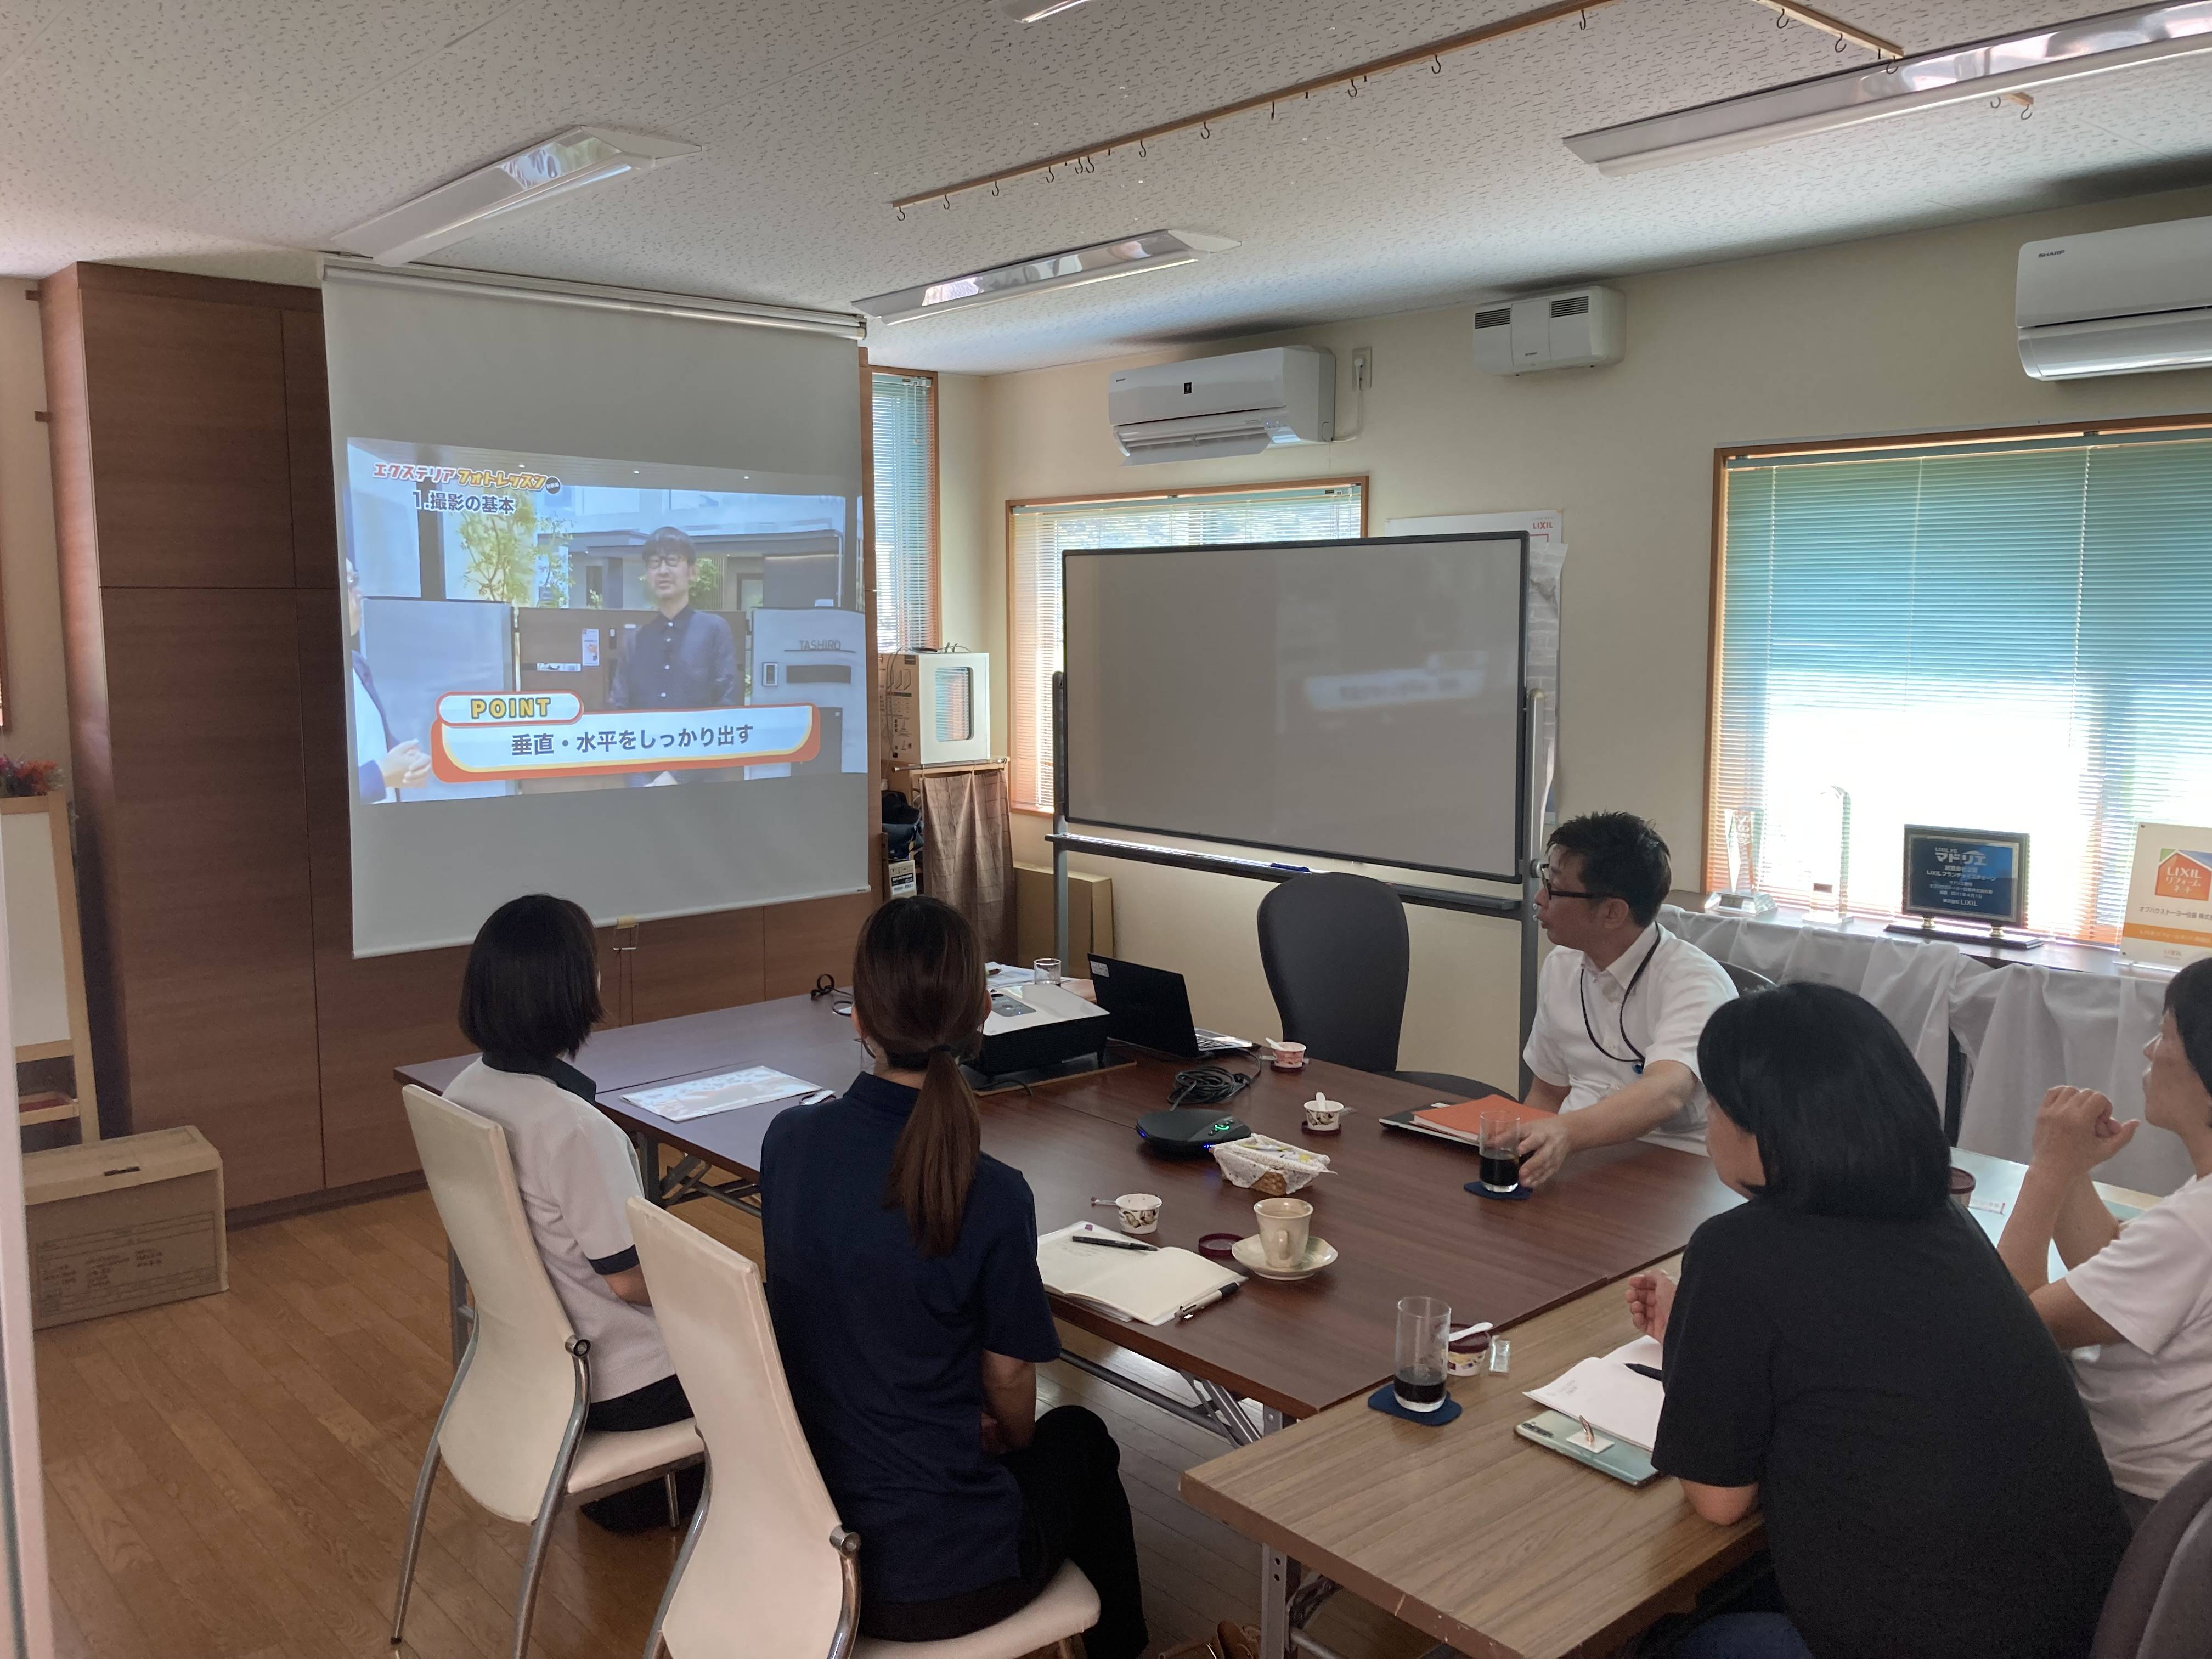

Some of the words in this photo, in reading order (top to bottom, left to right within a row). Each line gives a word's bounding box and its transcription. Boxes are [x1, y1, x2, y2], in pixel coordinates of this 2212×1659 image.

[2038, 250, 2065, 258] SHARP
[413, 490, 516, 514] 1.撮影の基本
[799, 639, 842, 650] TASHIRO
[470, 697, 552, 719] POINT
[511, 724, 754, 757] 垂直・水平をしっかり出す
[1936, 852, 1987, 866] マドリエ
[2167, 866, 2203, 879] LIXIL
